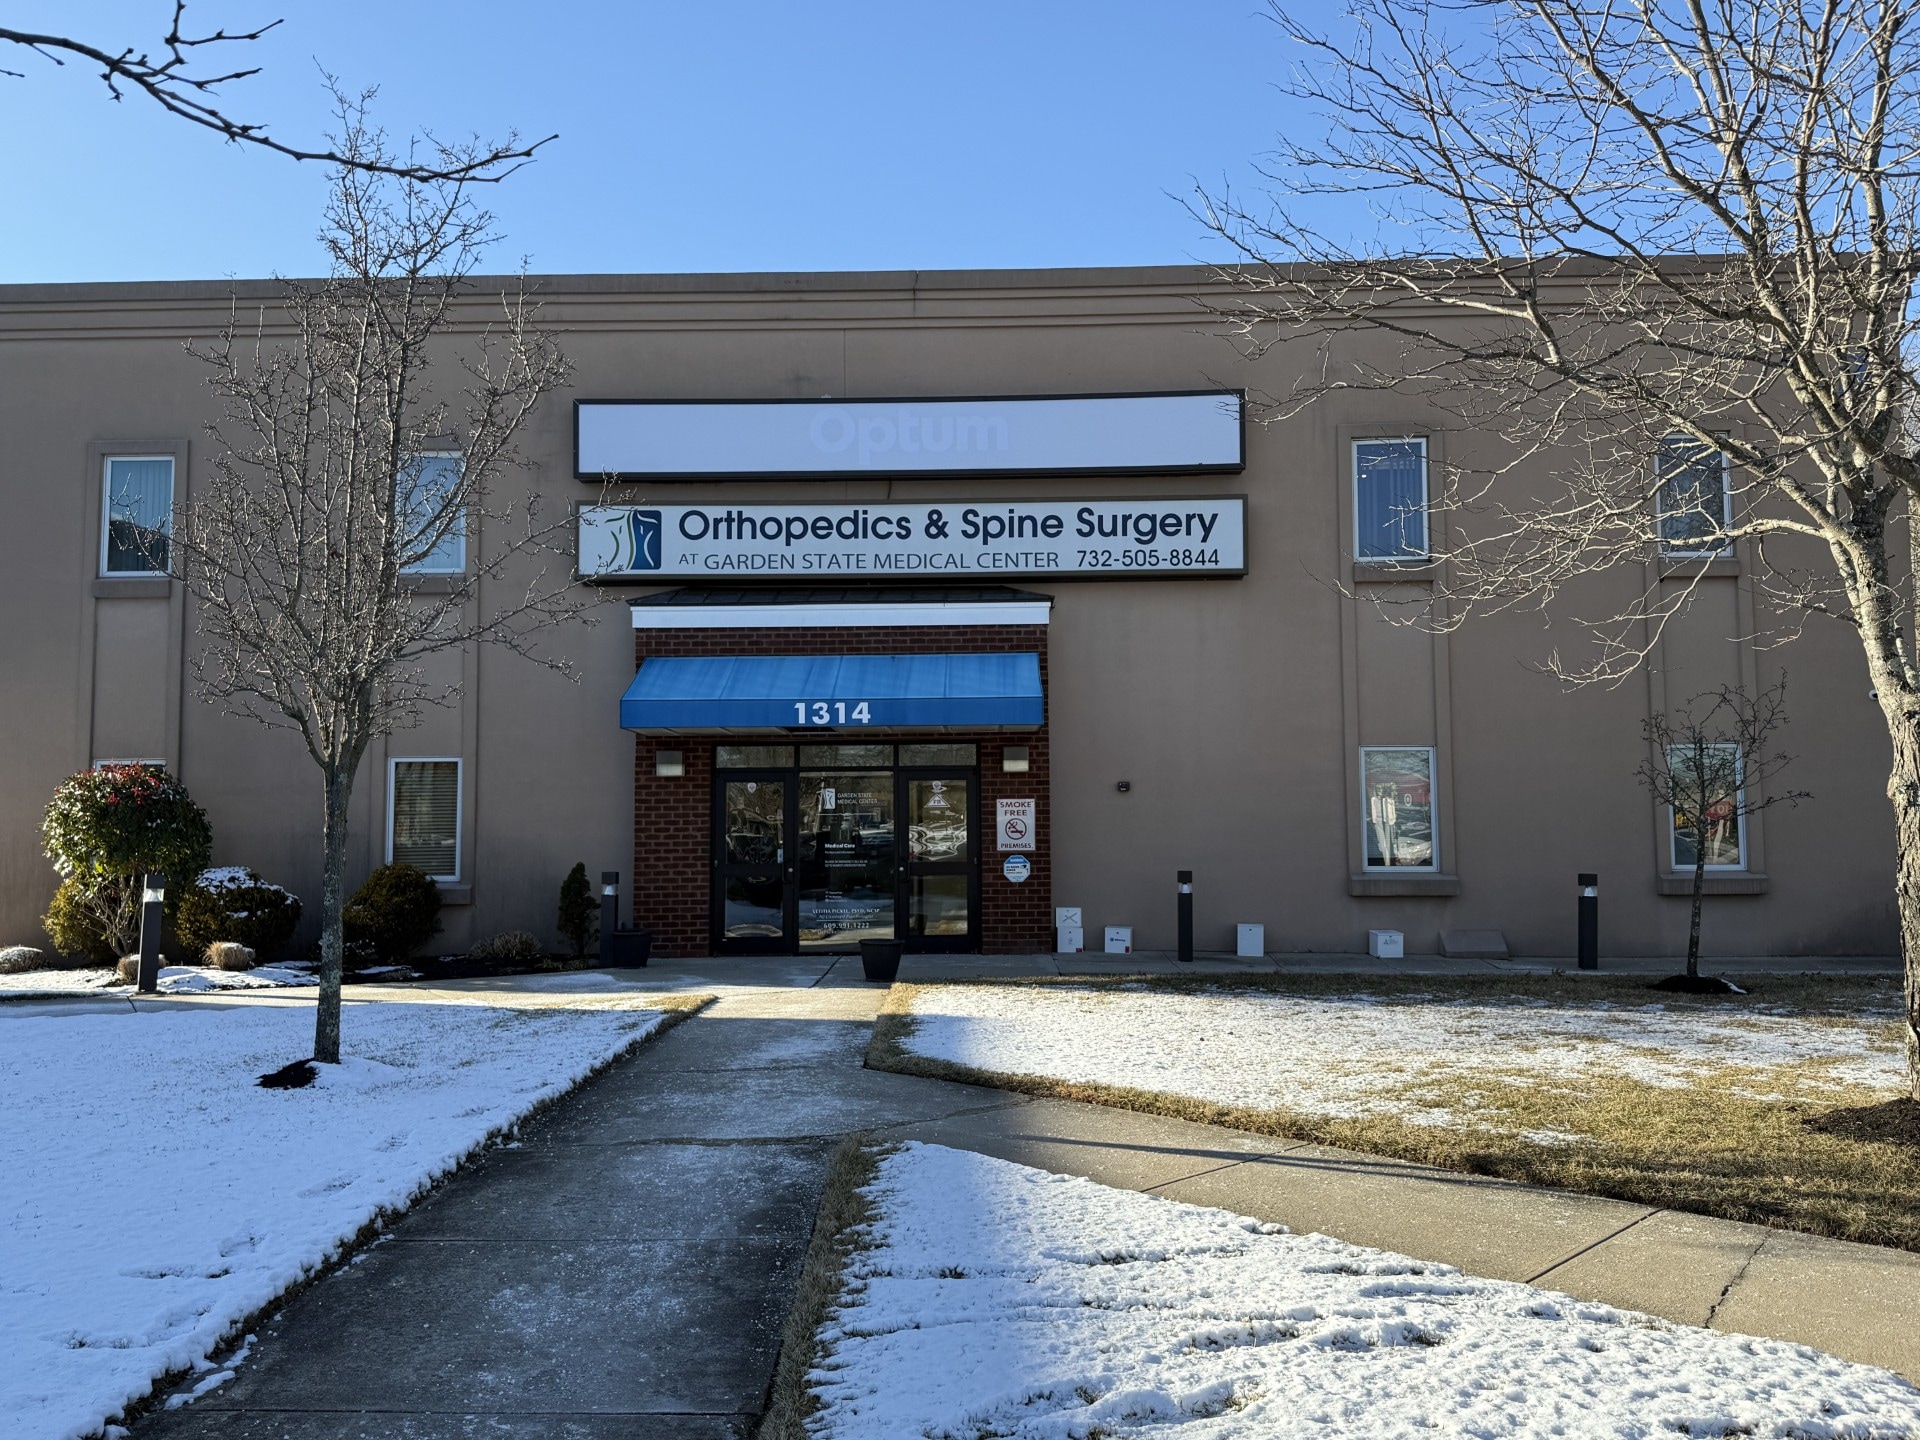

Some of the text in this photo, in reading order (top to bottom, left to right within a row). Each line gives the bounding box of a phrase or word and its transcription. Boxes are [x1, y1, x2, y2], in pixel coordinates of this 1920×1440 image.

[809, 407, 1008, 461] Optum
[678, 507, 1219, 547] Orthopedics & Spine Surgery
[678, 549, 1220, 570] AT GARDEN STATE MEDICAL CENTER 732-505-8844
[794, 702, 871, 725] 1314
